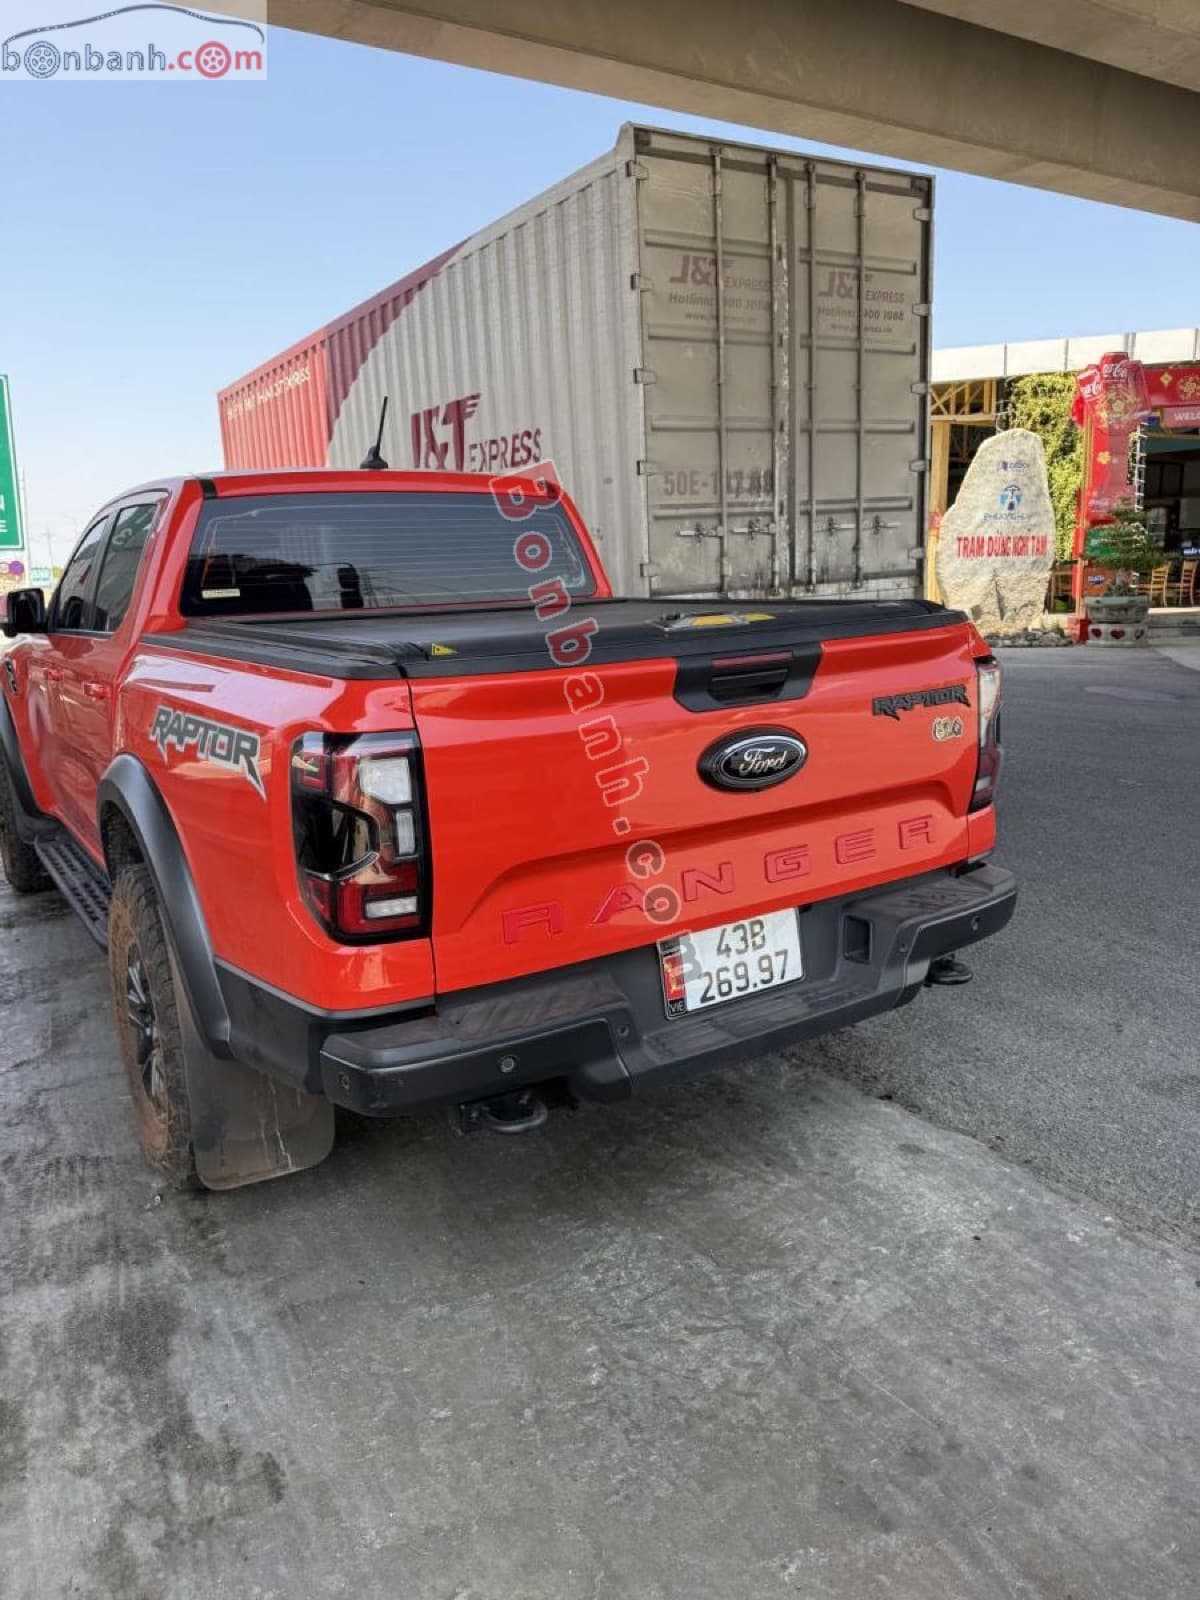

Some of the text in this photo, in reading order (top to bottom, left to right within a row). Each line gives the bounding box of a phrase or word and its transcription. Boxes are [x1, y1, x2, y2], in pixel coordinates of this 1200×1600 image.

[864, 289, 905, 304] EXPRESS
[468, 427, 542, 473] EXPRESS
[872, 684, 971, 721] RAPTOR
[148, 704, 268, 804] RAPTOR
[739, 746, 788, 777] Ford
[502, 814, 936, 945] RANGER
[716, 919, 766, 958] 43B
[700, 949, 789, 1004] 269.97
